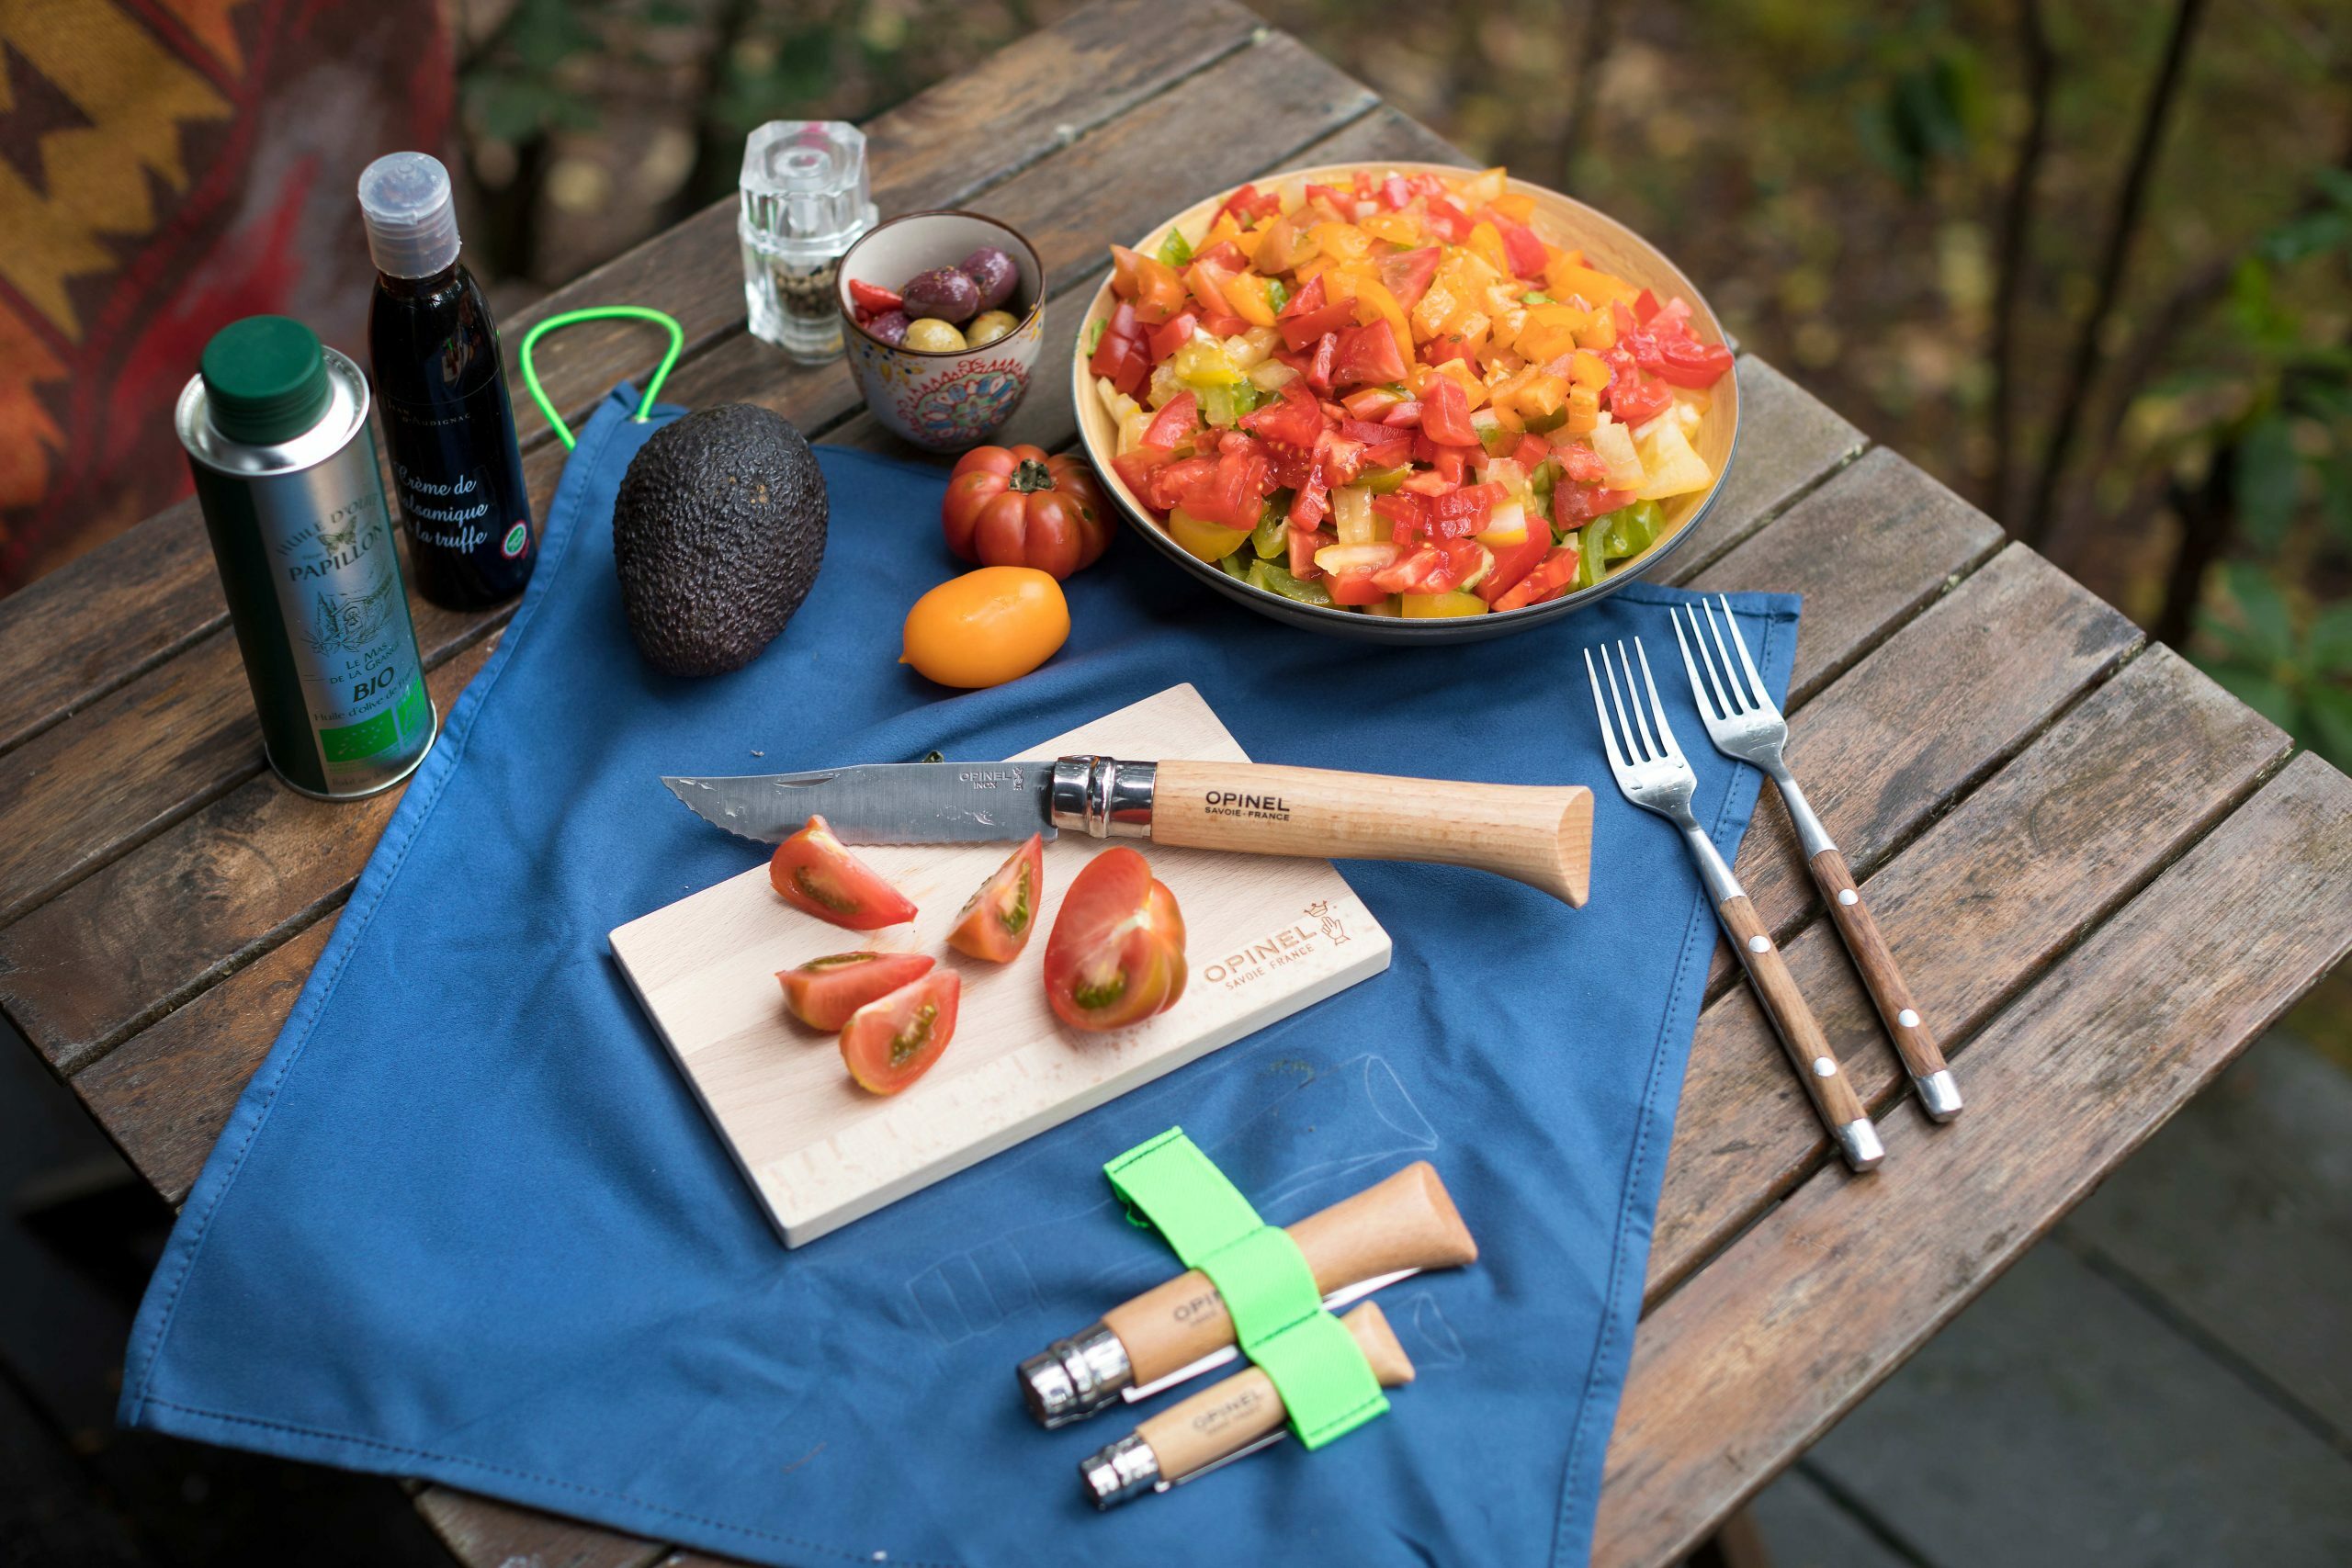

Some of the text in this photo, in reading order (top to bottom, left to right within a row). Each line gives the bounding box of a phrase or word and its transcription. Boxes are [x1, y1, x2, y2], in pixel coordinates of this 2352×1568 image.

[398, 465, 477, 496] Crème de
[402, 493, 489, 528] alsamique
[276, 521, 326, 557] HUILE
[288, 525, 383, 582] PAPILLON
[415, 521, 435, 544] la
[435, 525, 489, 555] truffe
[345, 643, 388, 670] LE MAS
[331, 675, 345, 684] DE
[349, 670, 362, 680] LA
[353, 666, 394, 703] BIO
[314, 713, 345, 721] Huile
[348, 697, 384, 717] d'olive
[959, 771, 1012, 782] OPINEL
[974, 781, 998, 790] INOX
[1204, 807, 1290, 821] SAVOIE FRANCE
[1205, 791, 1291, 812] OPINEL
[1204, 926, 1317, 983] OPINEL
[1226, 942, 1315, 990] SAVOIE FRANCE
